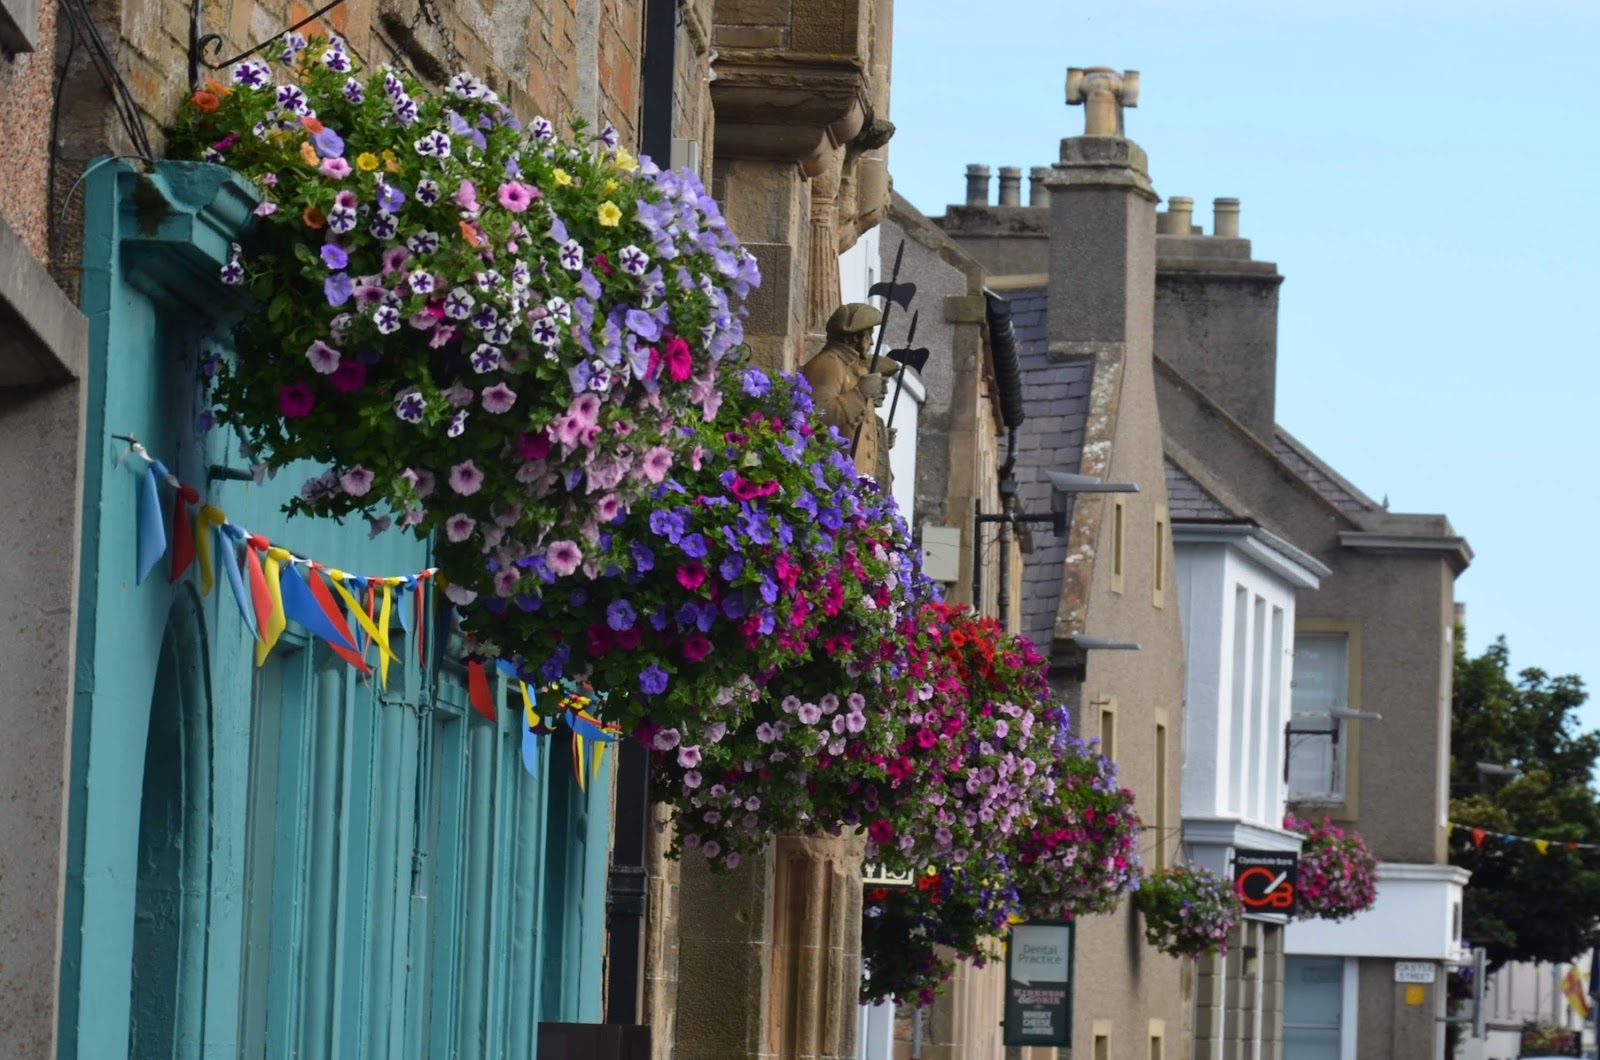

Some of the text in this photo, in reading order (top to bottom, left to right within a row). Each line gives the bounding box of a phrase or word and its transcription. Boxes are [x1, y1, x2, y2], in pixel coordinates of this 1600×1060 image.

[1238, 856, 1275, 865] Clydesdale
[1023, 944, 1058, 954] Dental
[1019, 954, 1062, 964] Practice
[1399, 963, 1433, 971] CASTLE
[1023, 1011, 1052, 1019] WHISKY
